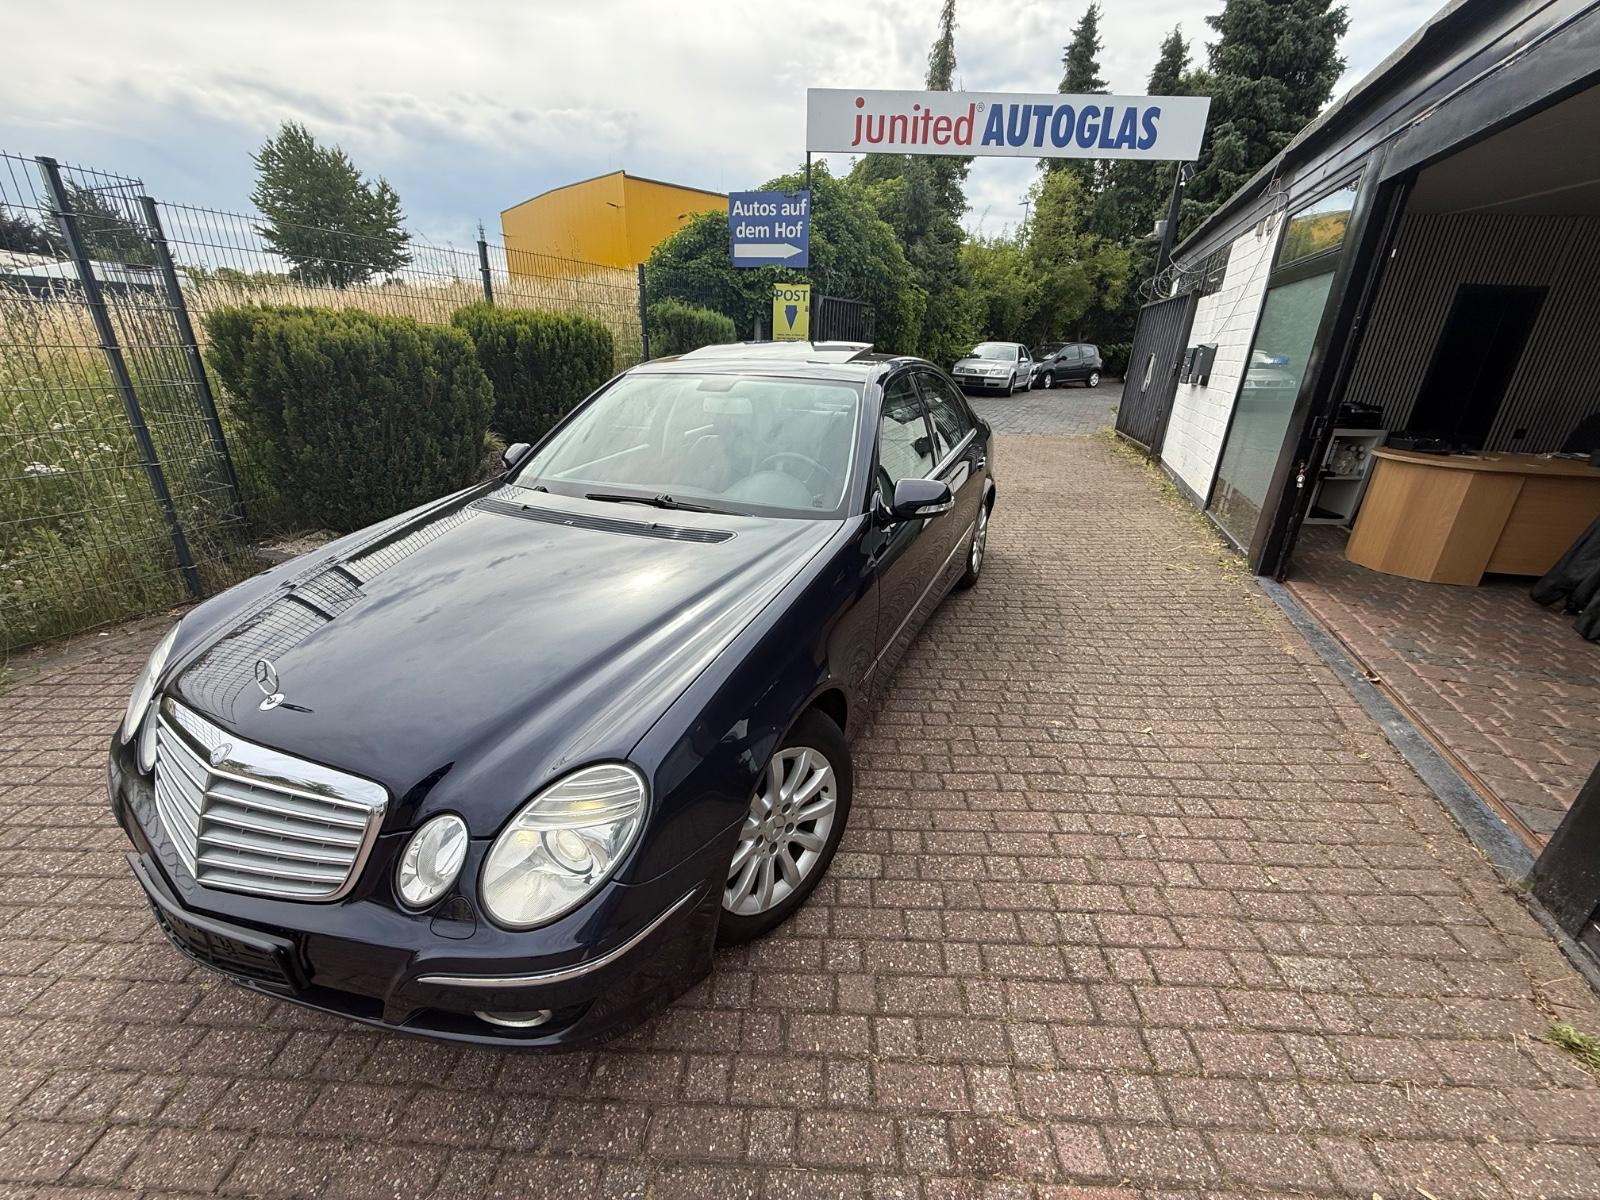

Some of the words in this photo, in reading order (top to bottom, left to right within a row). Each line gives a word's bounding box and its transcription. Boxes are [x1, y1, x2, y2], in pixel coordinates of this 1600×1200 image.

[982, 103, 1161, 150] AUTOGLAS
[732, 200, 776, 216] Autos
[781, 199, 807, 216] auf
[736, 221, 769, 238] dem
[775, 221, 803, 238] Hof
[775, 289, 808, 302] POST
